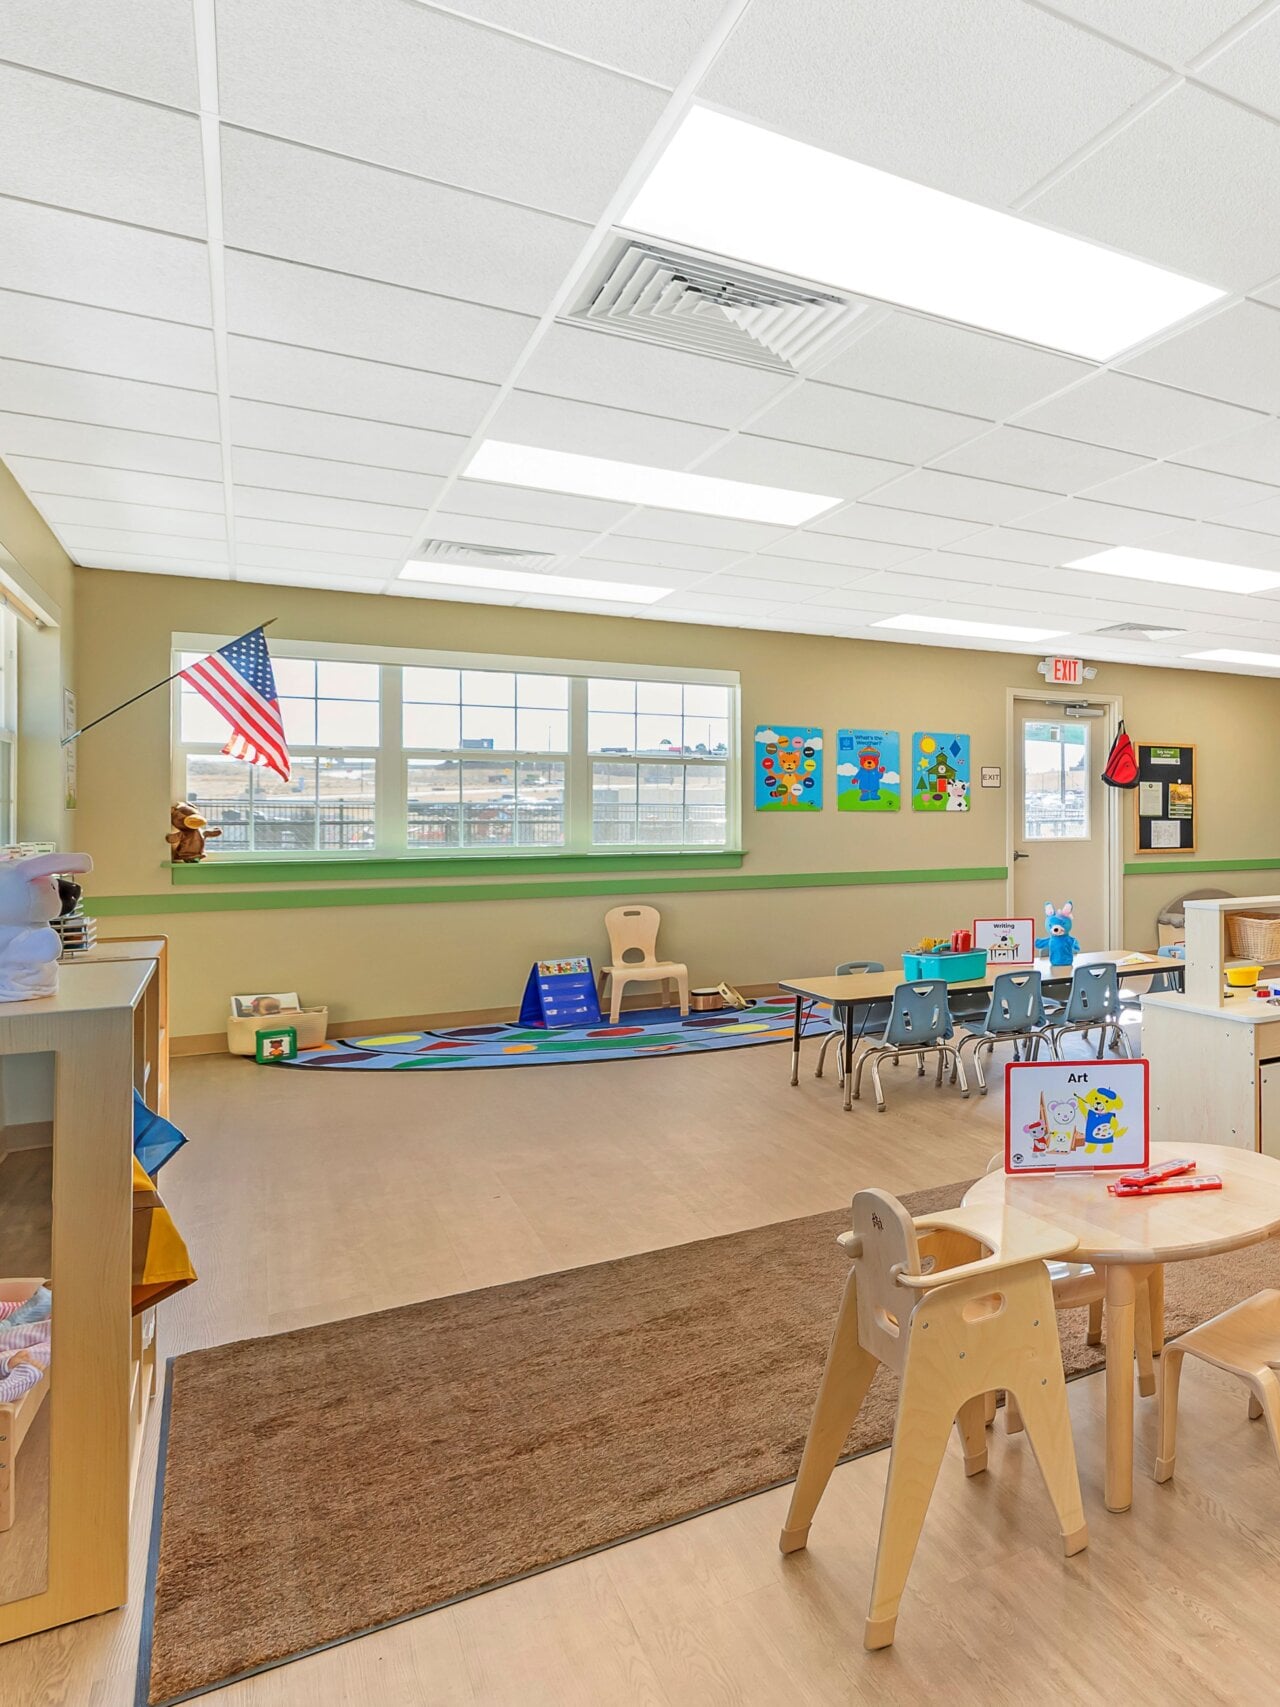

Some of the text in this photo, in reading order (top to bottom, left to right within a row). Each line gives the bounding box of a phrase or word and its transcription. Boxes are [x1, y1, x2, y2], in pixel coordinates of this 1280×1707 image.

[1054, 659, 1078, 681] EXIT
[993, 922, 1015, 930] Writing
[1067, 1072, 1088, 1083] Art
